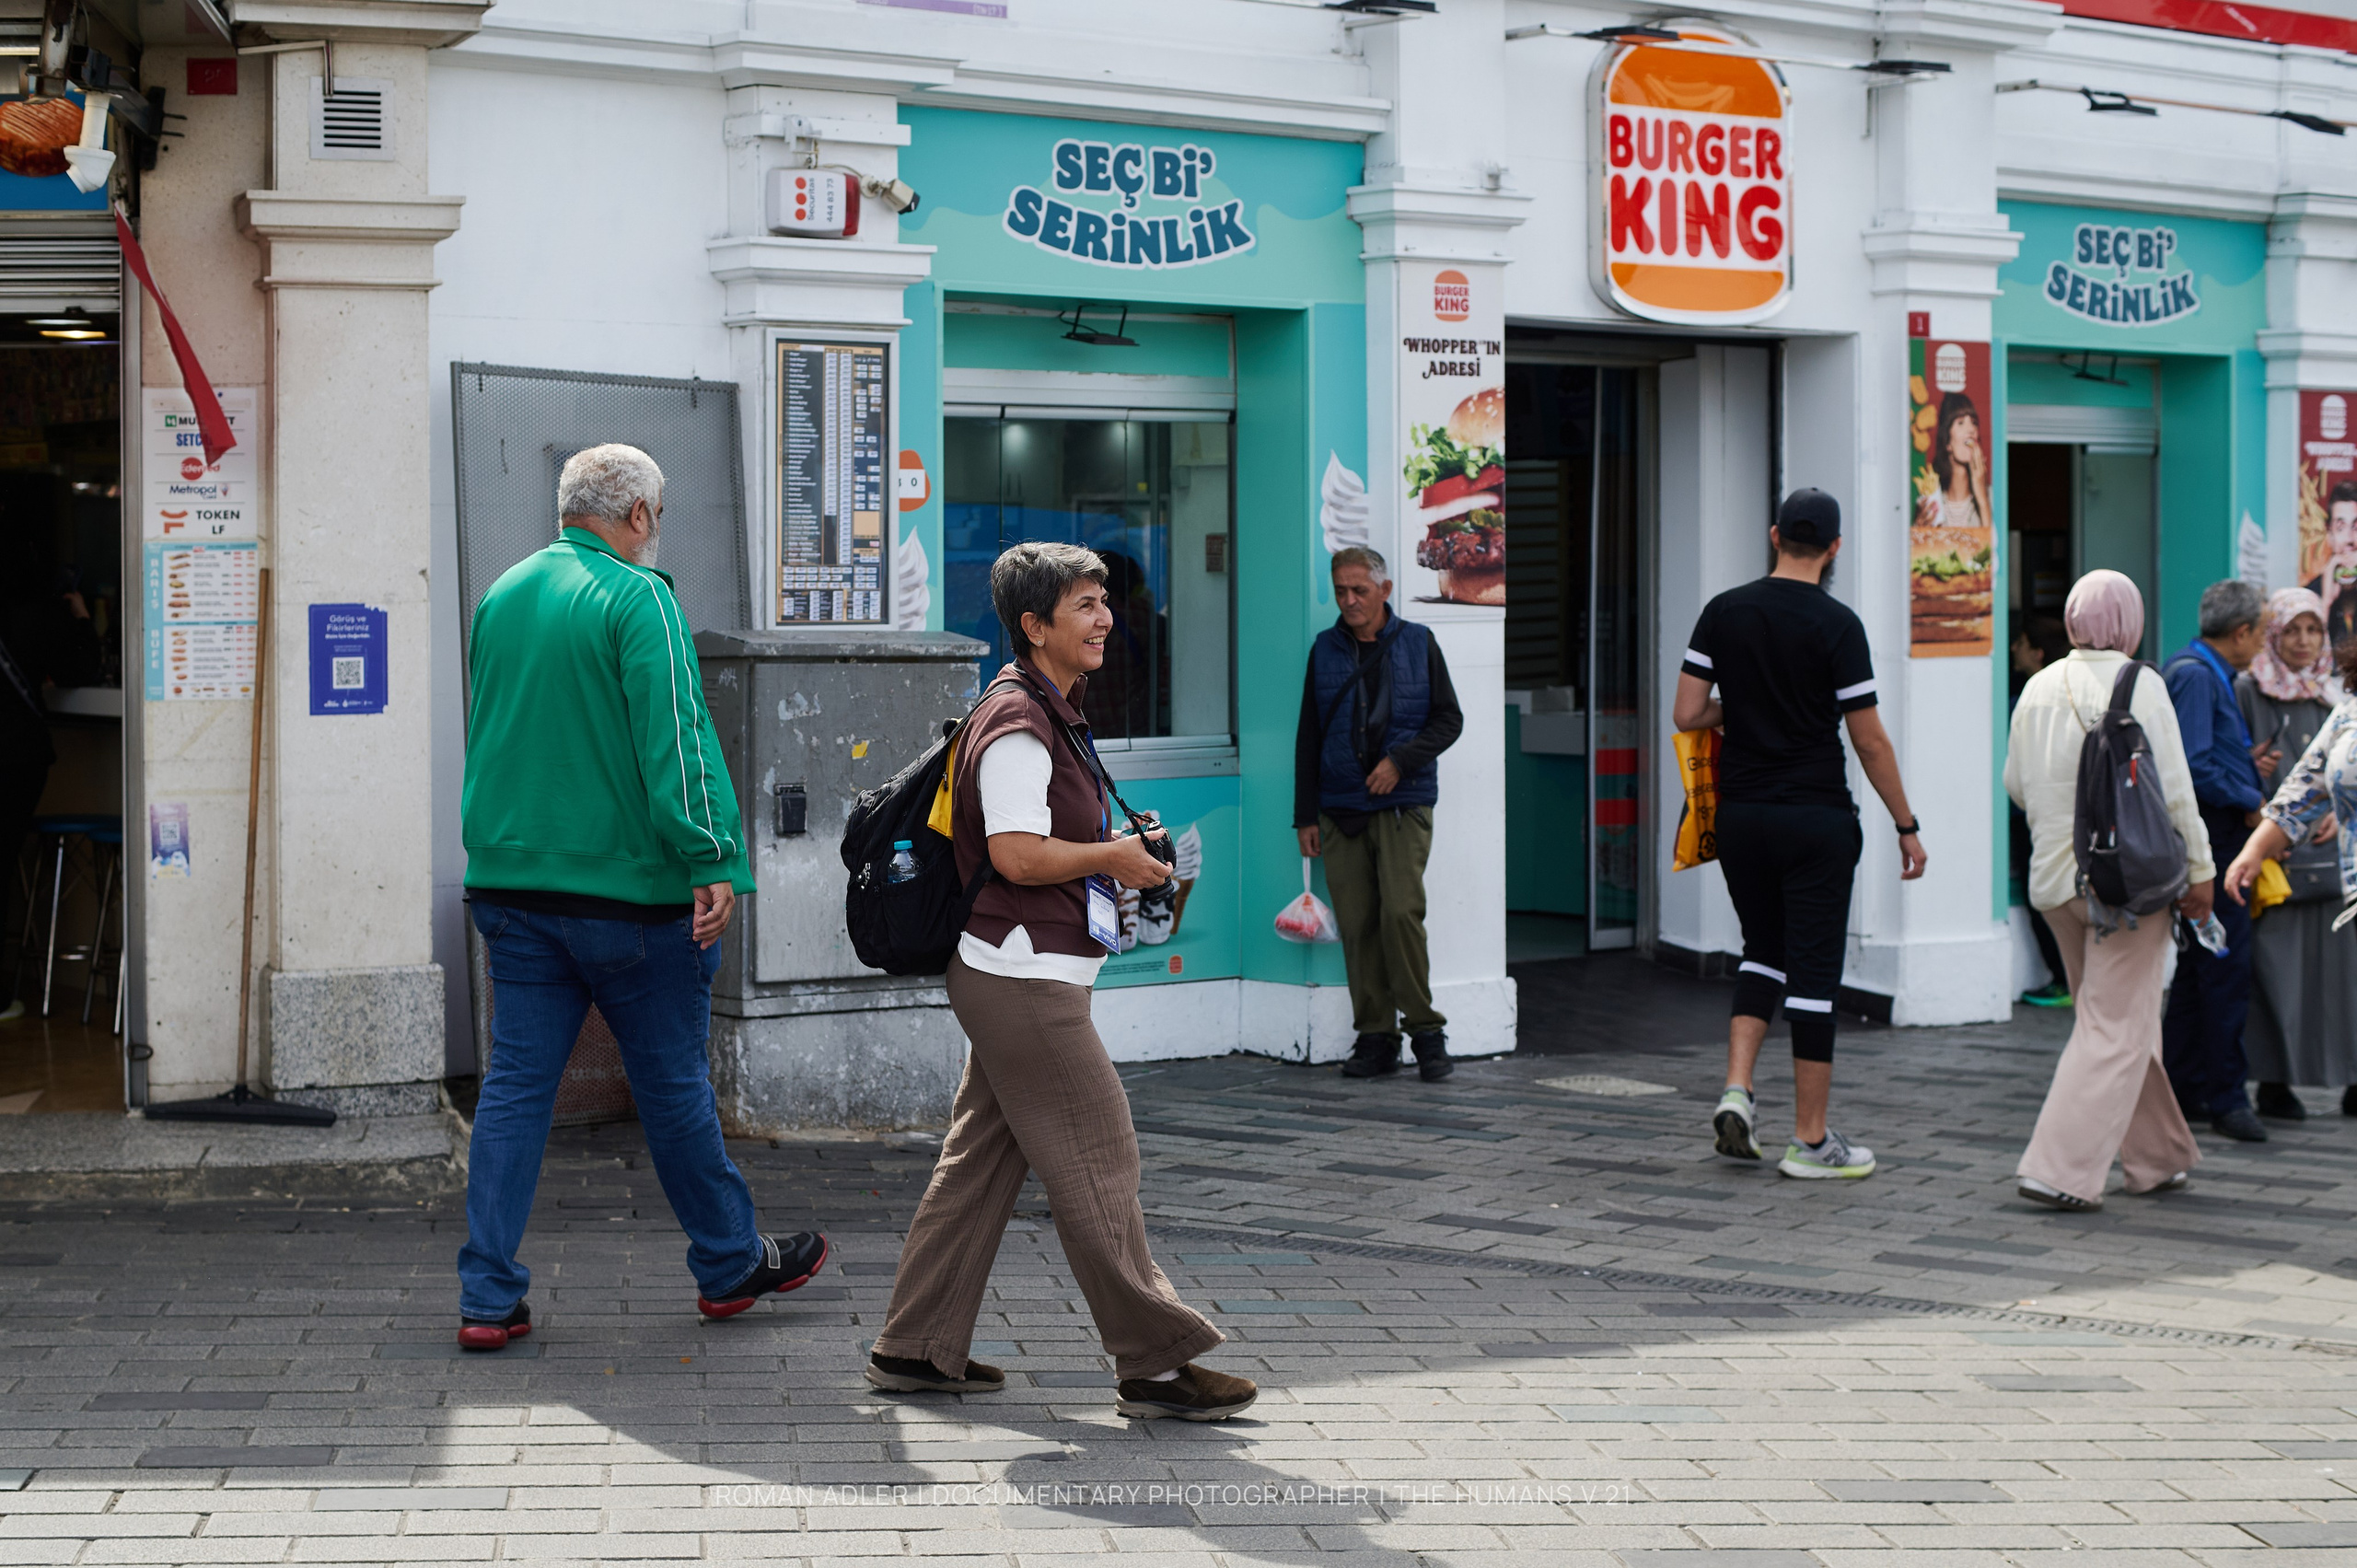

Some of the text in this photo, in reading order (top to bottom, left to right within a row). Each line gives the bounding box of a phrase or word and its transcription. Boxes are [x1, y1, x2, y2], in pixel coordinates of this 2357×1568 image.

[1609, 114, 1782, 180] BURGER
[1055, 142, 1144, 208] SEÇ
[827, 178, 834, 188] 73
[827, 191, 834, 203] 83
[1610, 173, 1783, 261] KING
[2077, 227, 2131, 278] SEÇ
[1434, 285, 1469, 296] BURGER
[1434, 297, 1469, 312] KING
[1422, 356, 1480, 379] ADRESİ
[169, 484, 217, 494] Metropol
[196, 509, 240, 520] TOKEN
[212, 525, 226, 535] LF
